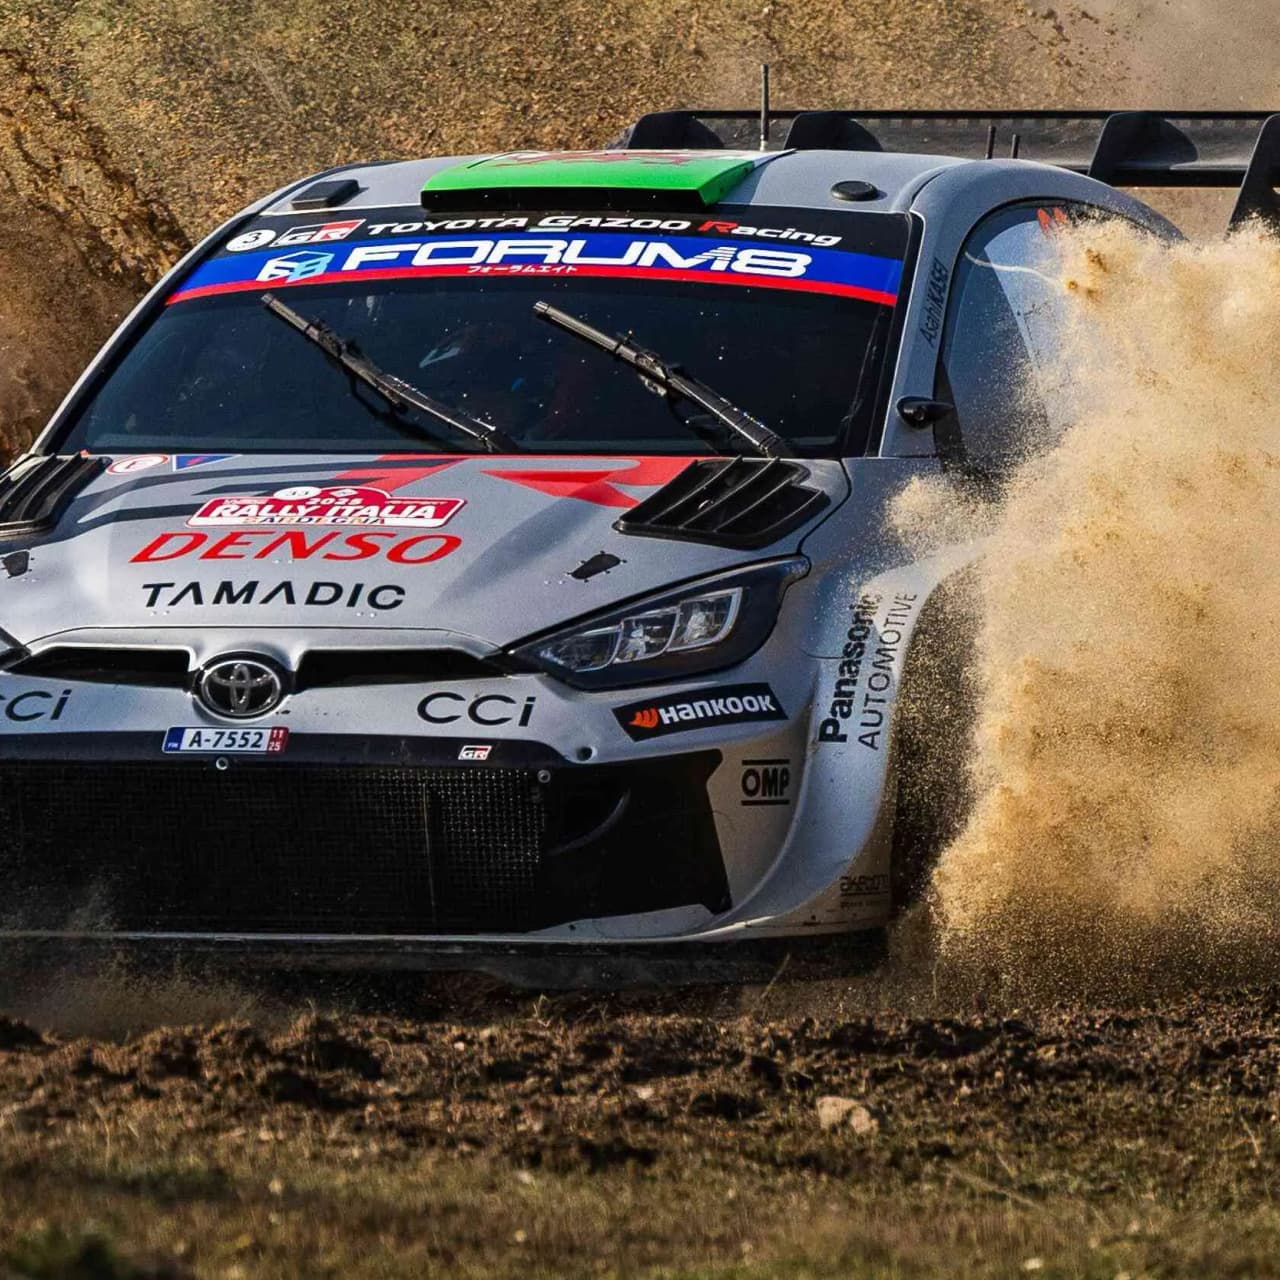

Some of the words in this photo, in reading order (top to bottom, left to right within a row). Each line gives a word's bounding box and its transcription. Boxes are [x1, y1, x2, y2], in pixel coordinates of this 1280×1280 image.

[273, 226, 355, 246] GR
[367, 217, 529, 236] TOYOTA
[538, 215, 691, 231] GAZOO
[698, 220, 842, 248] Racing
[341, 239, 812, 278] FORUM8
[467, 265, 578, 274] フォーラムエイト
[212, 504, 319, 518] RALLY
[328, 504, 435, 519] ITALIA
[305, 497, 364, 505] 2025
[129, 531, 463, 565] DENSO
[141, 580, 407, 610] TAMADIC
[857, 592, 918, 751] AUTOMOTIVE
[417, 691, 537, 728] CCi
[188, 730, 263, 749] A-7552
[268, 741, 281, 752] 25
[272, 729, 284, 739] 11
[741, 767, 790, 797] OMP
